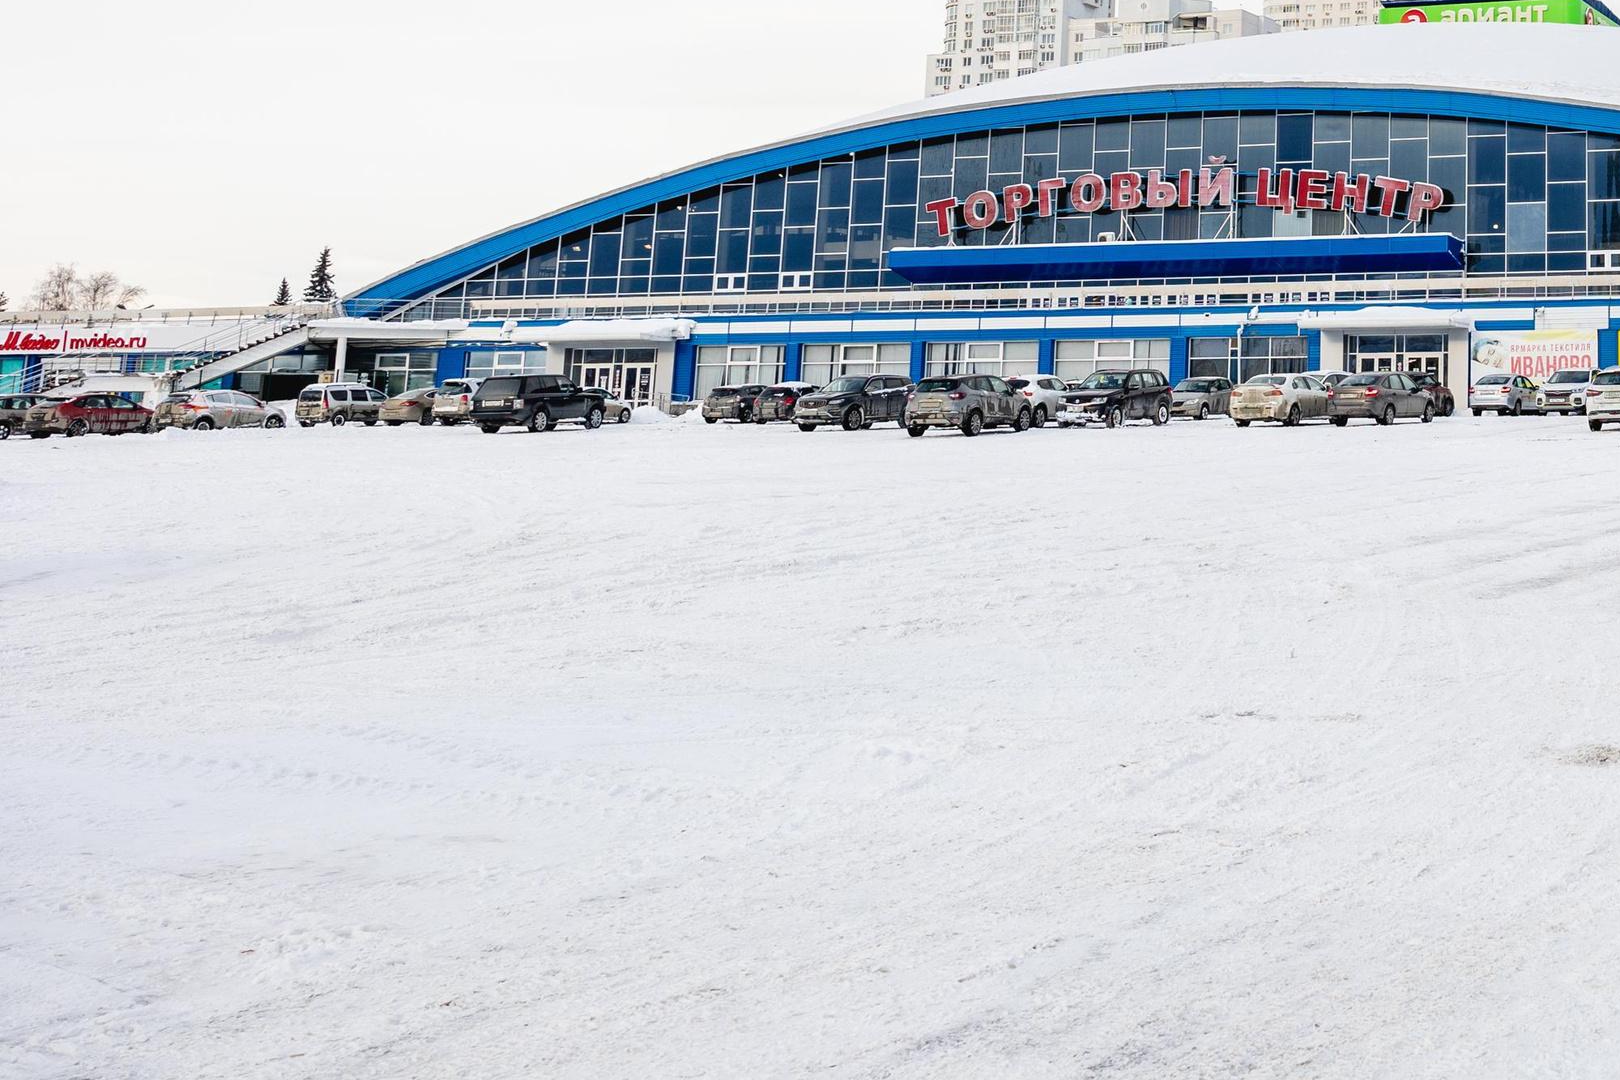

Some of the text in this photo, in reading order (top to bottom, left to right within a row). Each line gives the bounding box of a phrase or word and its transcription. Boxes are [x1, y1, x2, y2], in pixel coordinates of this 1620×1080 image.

[926, 154, 1445, 236] ТОРГОВЫЙ ЦЕНТР
[69, 333, 147, 349] mvideo.ru
[1510, 343, 1591, 353] ЯРМАРКА ТЕКСТИЛЯ
[1510, 354, 1592, 378] ИВАНОВО
